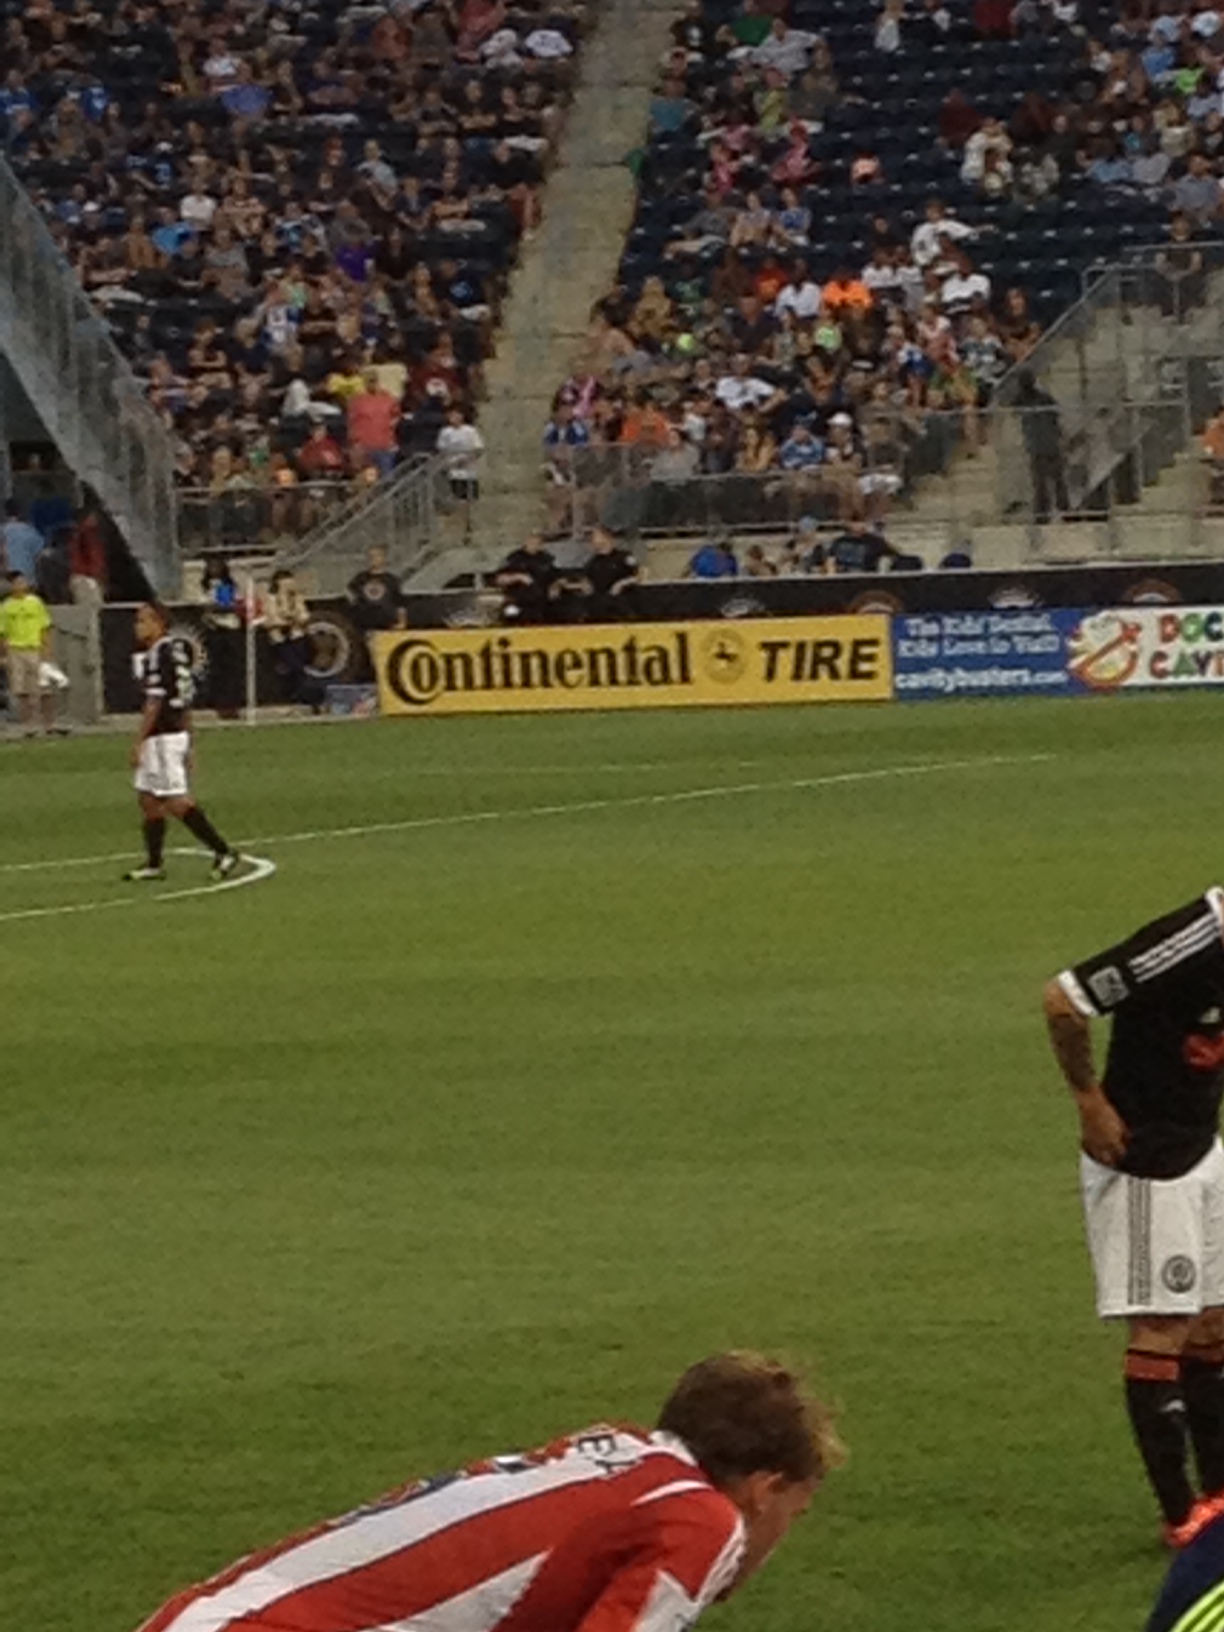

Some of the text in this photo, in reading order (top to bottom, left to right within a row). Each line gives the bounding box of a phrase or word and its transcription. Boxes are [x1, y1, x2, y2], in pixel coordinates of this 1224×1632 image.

[1159, 611, 1224, 643] DOC
[387, 631, 881, 706] Continental TIRE
